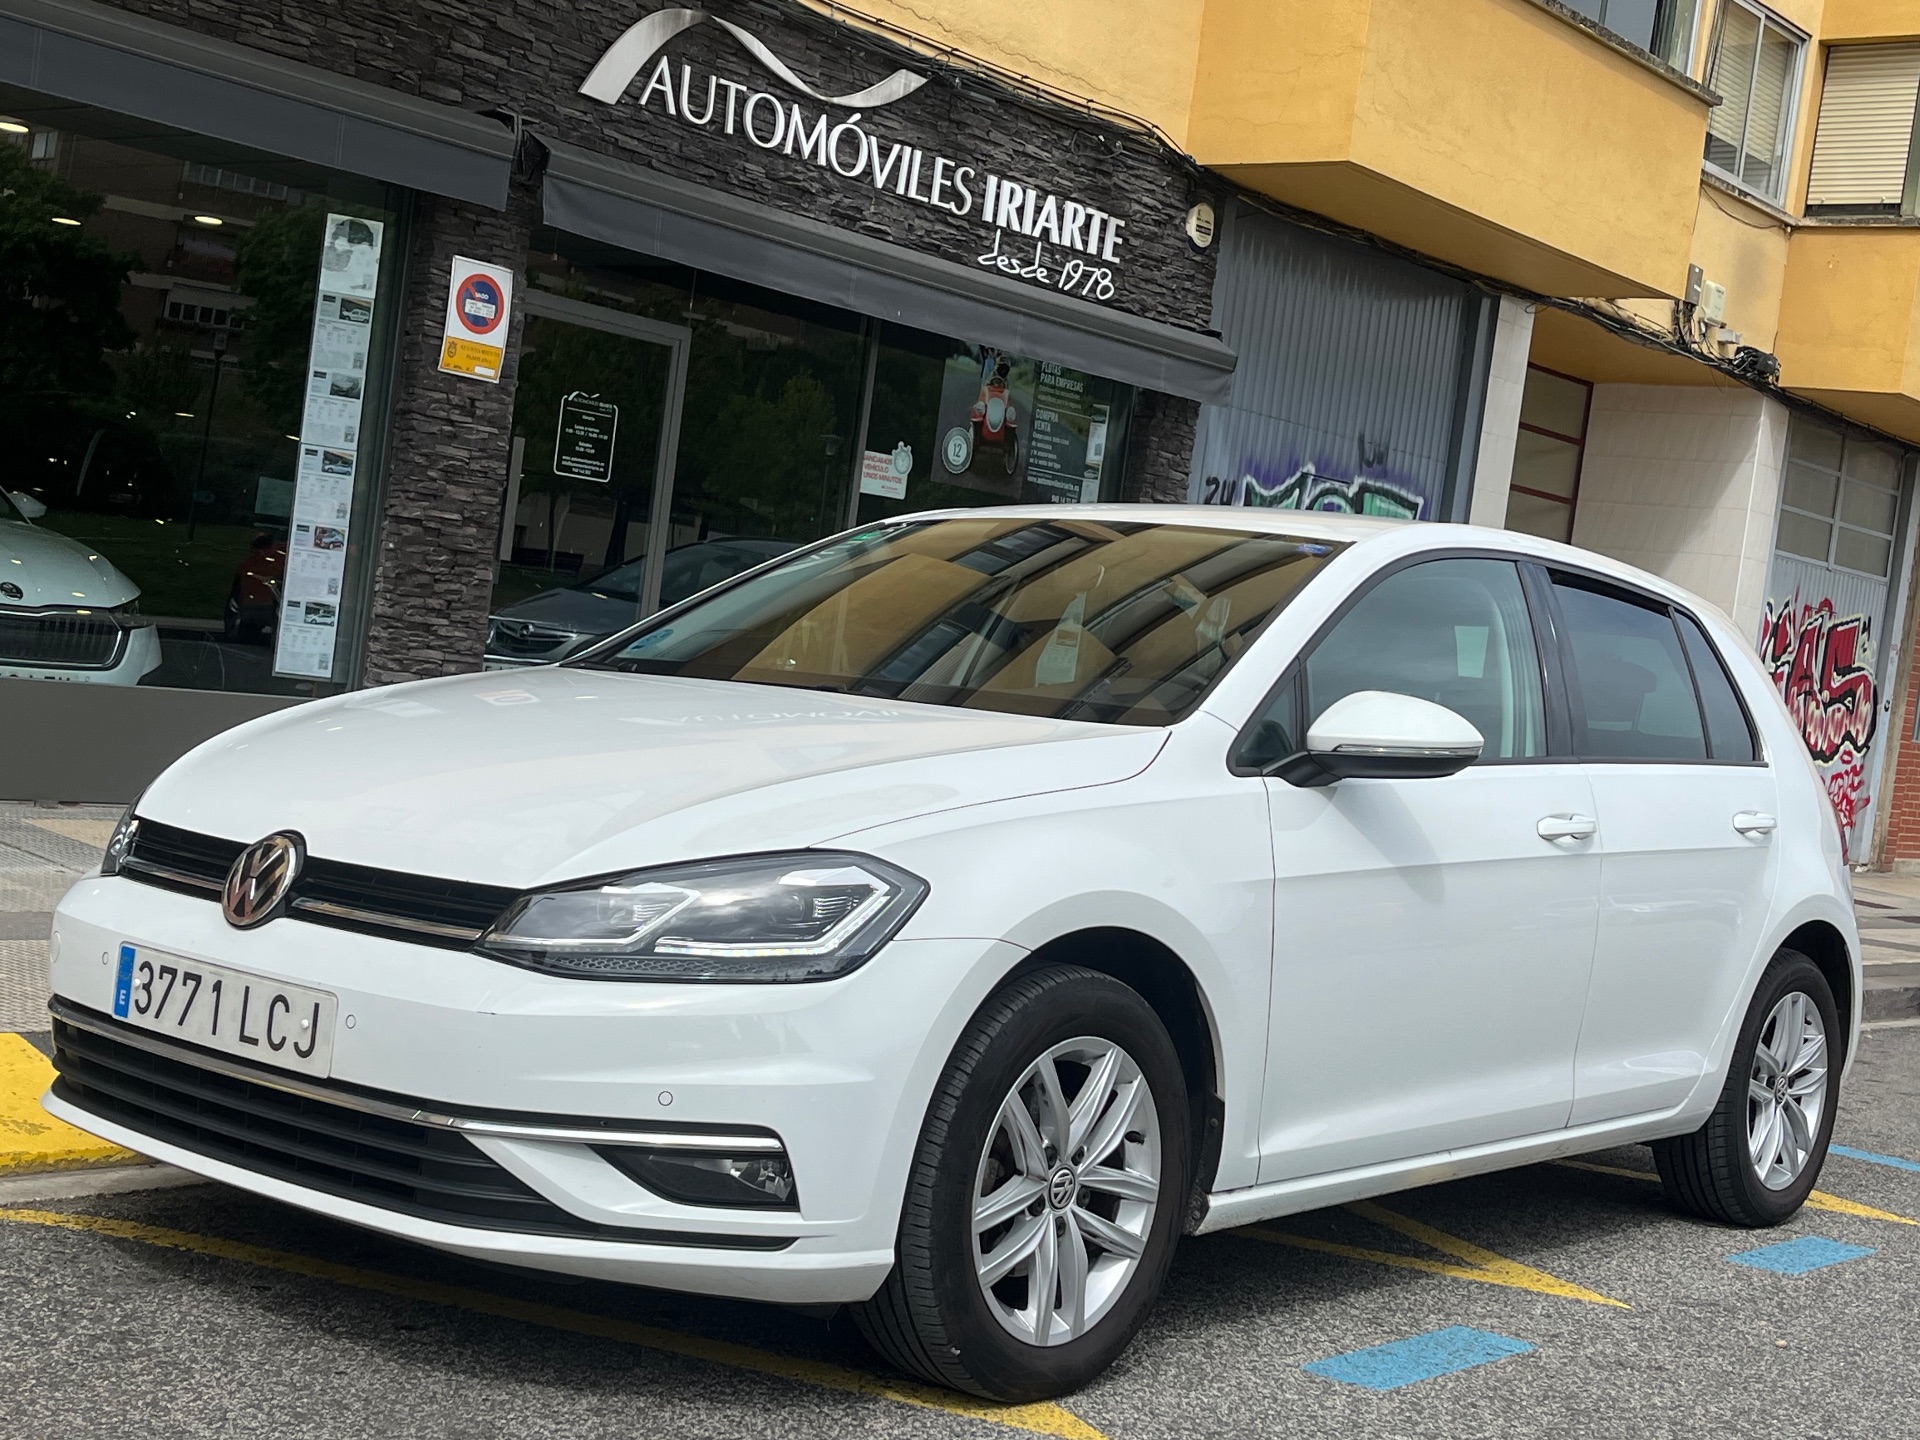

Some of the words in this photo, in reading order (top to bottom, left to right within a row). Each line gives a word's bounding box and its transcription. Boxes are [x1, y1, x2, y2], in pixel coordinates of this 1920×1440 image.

[638, 55, 976, 215] AUTOMÓVILES
[982, 175, 1126, 264] IRIARTE
[977, 229, 1050, 283] desde
[1058, 260, 1114, 300] 1978
[953, 442, 962, 458] 12
[134, 960, 222, 1036] 3771
[239, 985, 320, 1059] LCJ
